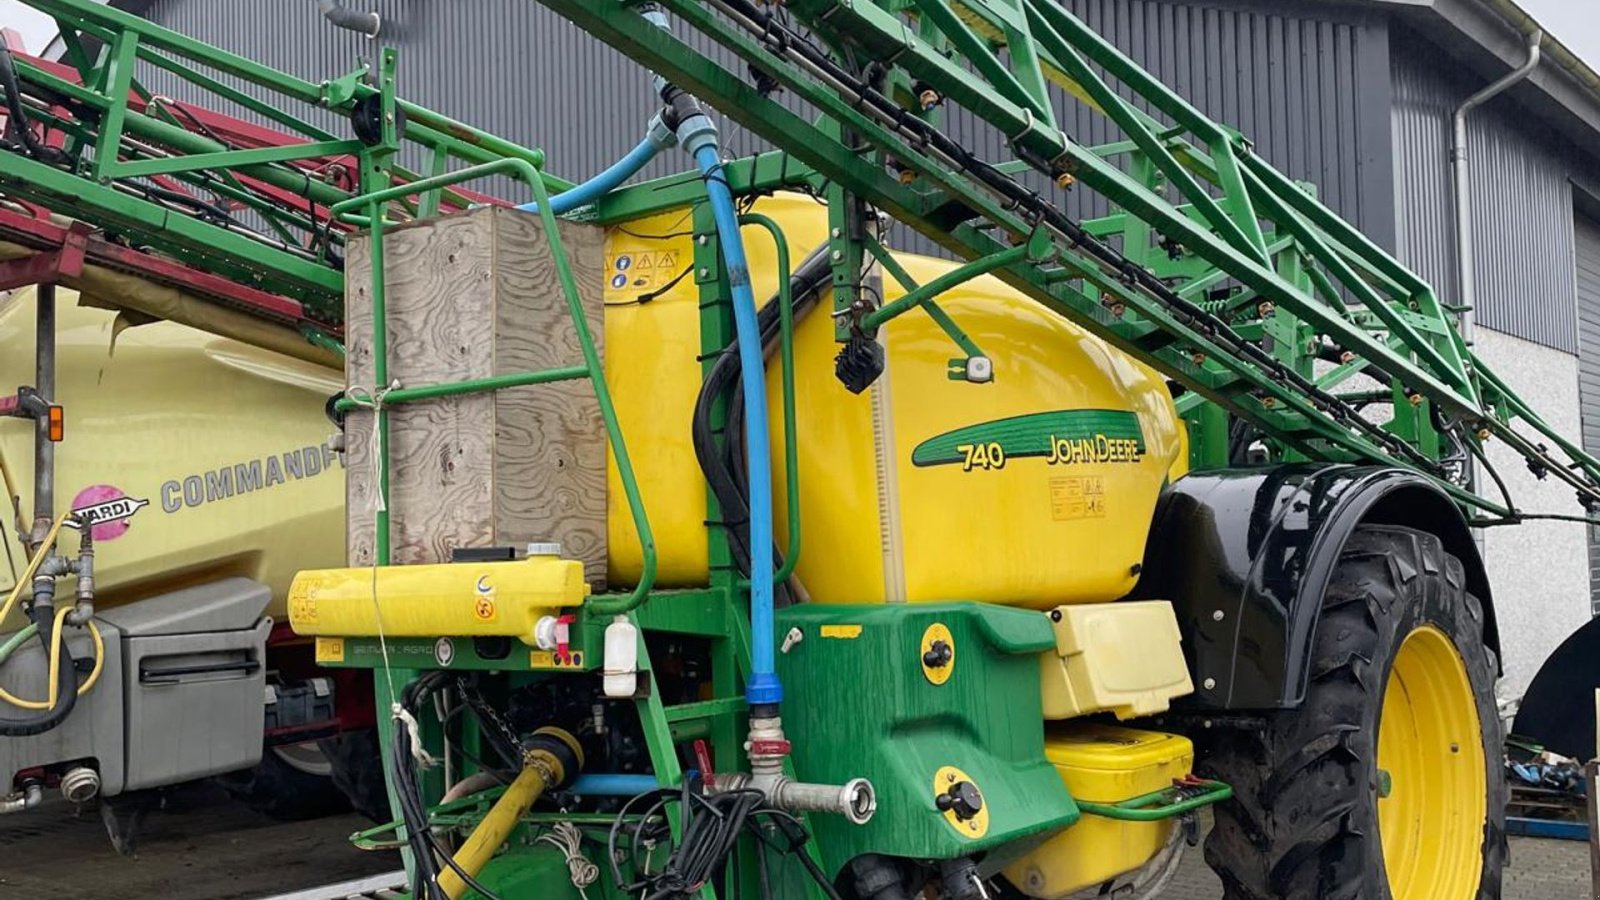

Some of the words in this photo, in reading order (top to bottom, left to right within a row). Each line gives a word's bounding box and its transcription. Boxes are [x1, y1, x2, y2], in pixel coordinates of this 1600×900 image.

[957, 442, 1006, 472] 740
[1047, 434, 1096, 465] JOHN
[1094, 433, 1141, 463] DEERE
[160, 442, 346, 513] COMMAND
[80, 501, 131, 521] ARDI
